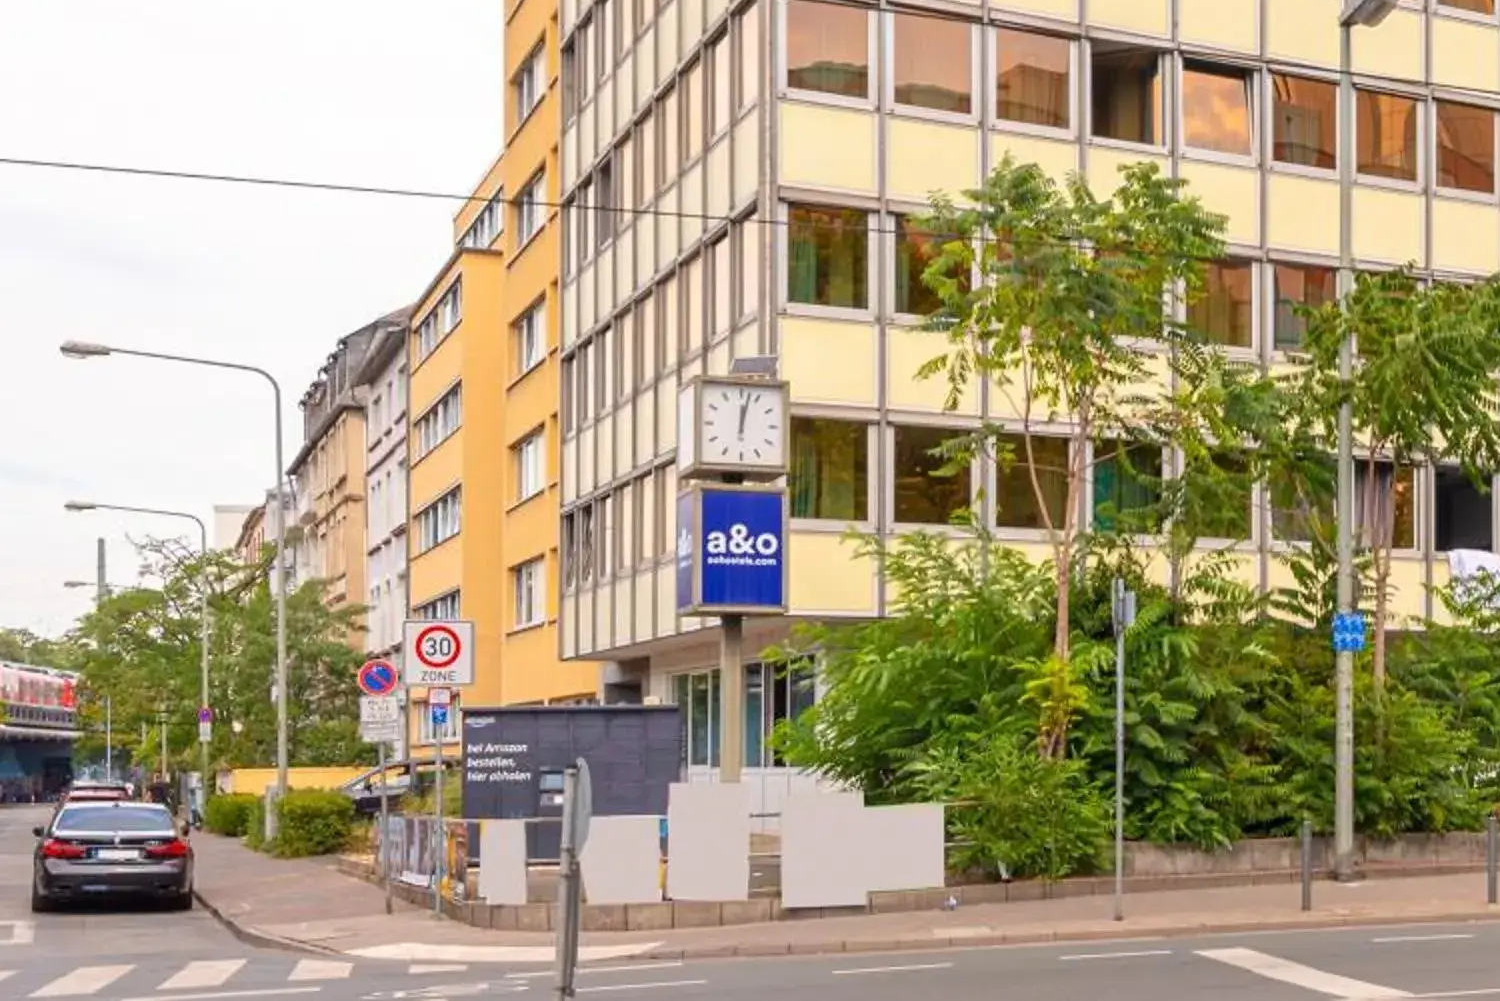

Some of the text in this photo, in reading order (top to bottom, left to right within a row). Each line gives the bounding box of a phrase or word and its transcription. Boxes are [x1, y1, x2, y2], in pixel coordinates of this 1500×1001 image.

[707, 524, 778, 555] a&o
[425, 637, 452, 657] 30
[421, 671, 457, 682] ZONE
[485, 743, 528, 754] Amazon
[467, 771, 532, 782] hier abholen
